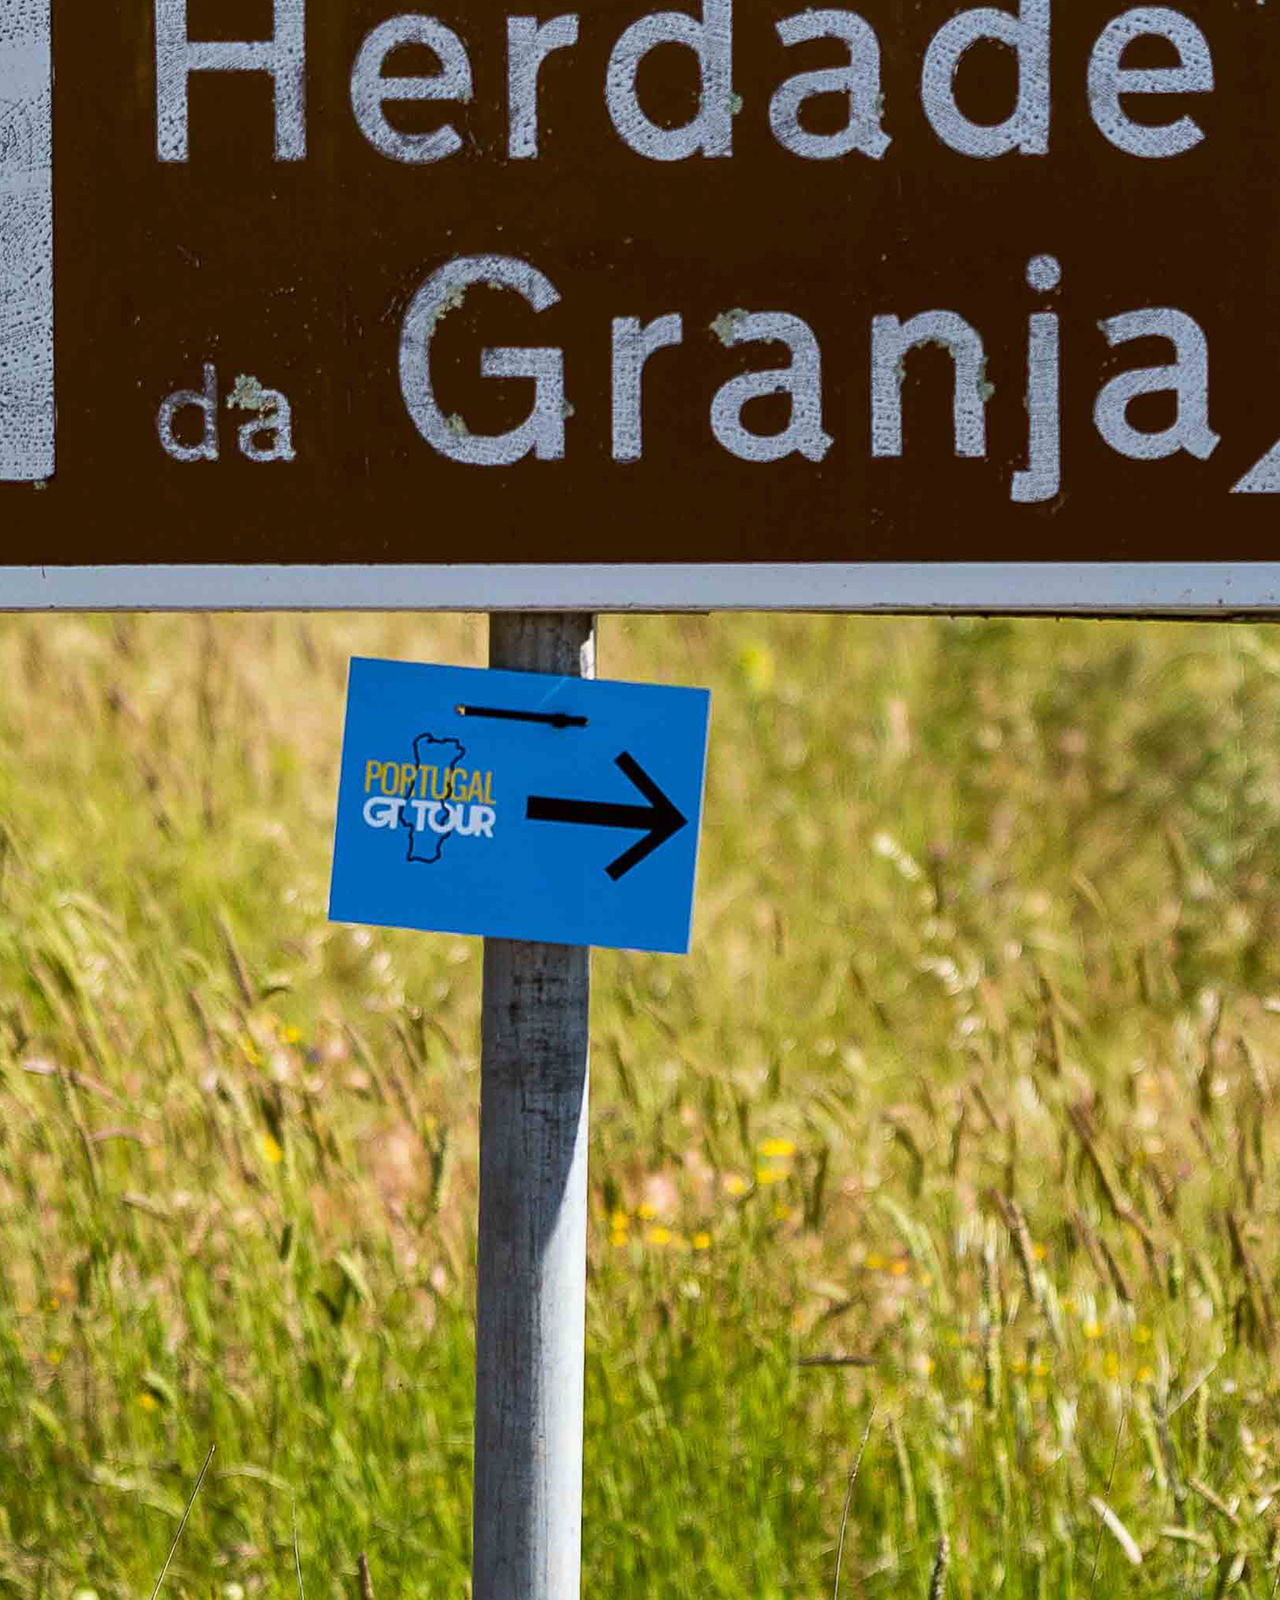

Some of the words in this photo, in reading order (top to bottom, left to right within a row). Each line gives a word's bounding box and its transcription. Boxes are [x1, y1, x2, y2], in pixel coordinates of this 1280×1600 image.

[156, 364, 296, 463] da
[399, 254, 1221, 503] Granja
[364, 760, 497, 804] PORTUGAL
[363, 796, 407, 829] GT
[411, 799, 496, 838] TOUR
